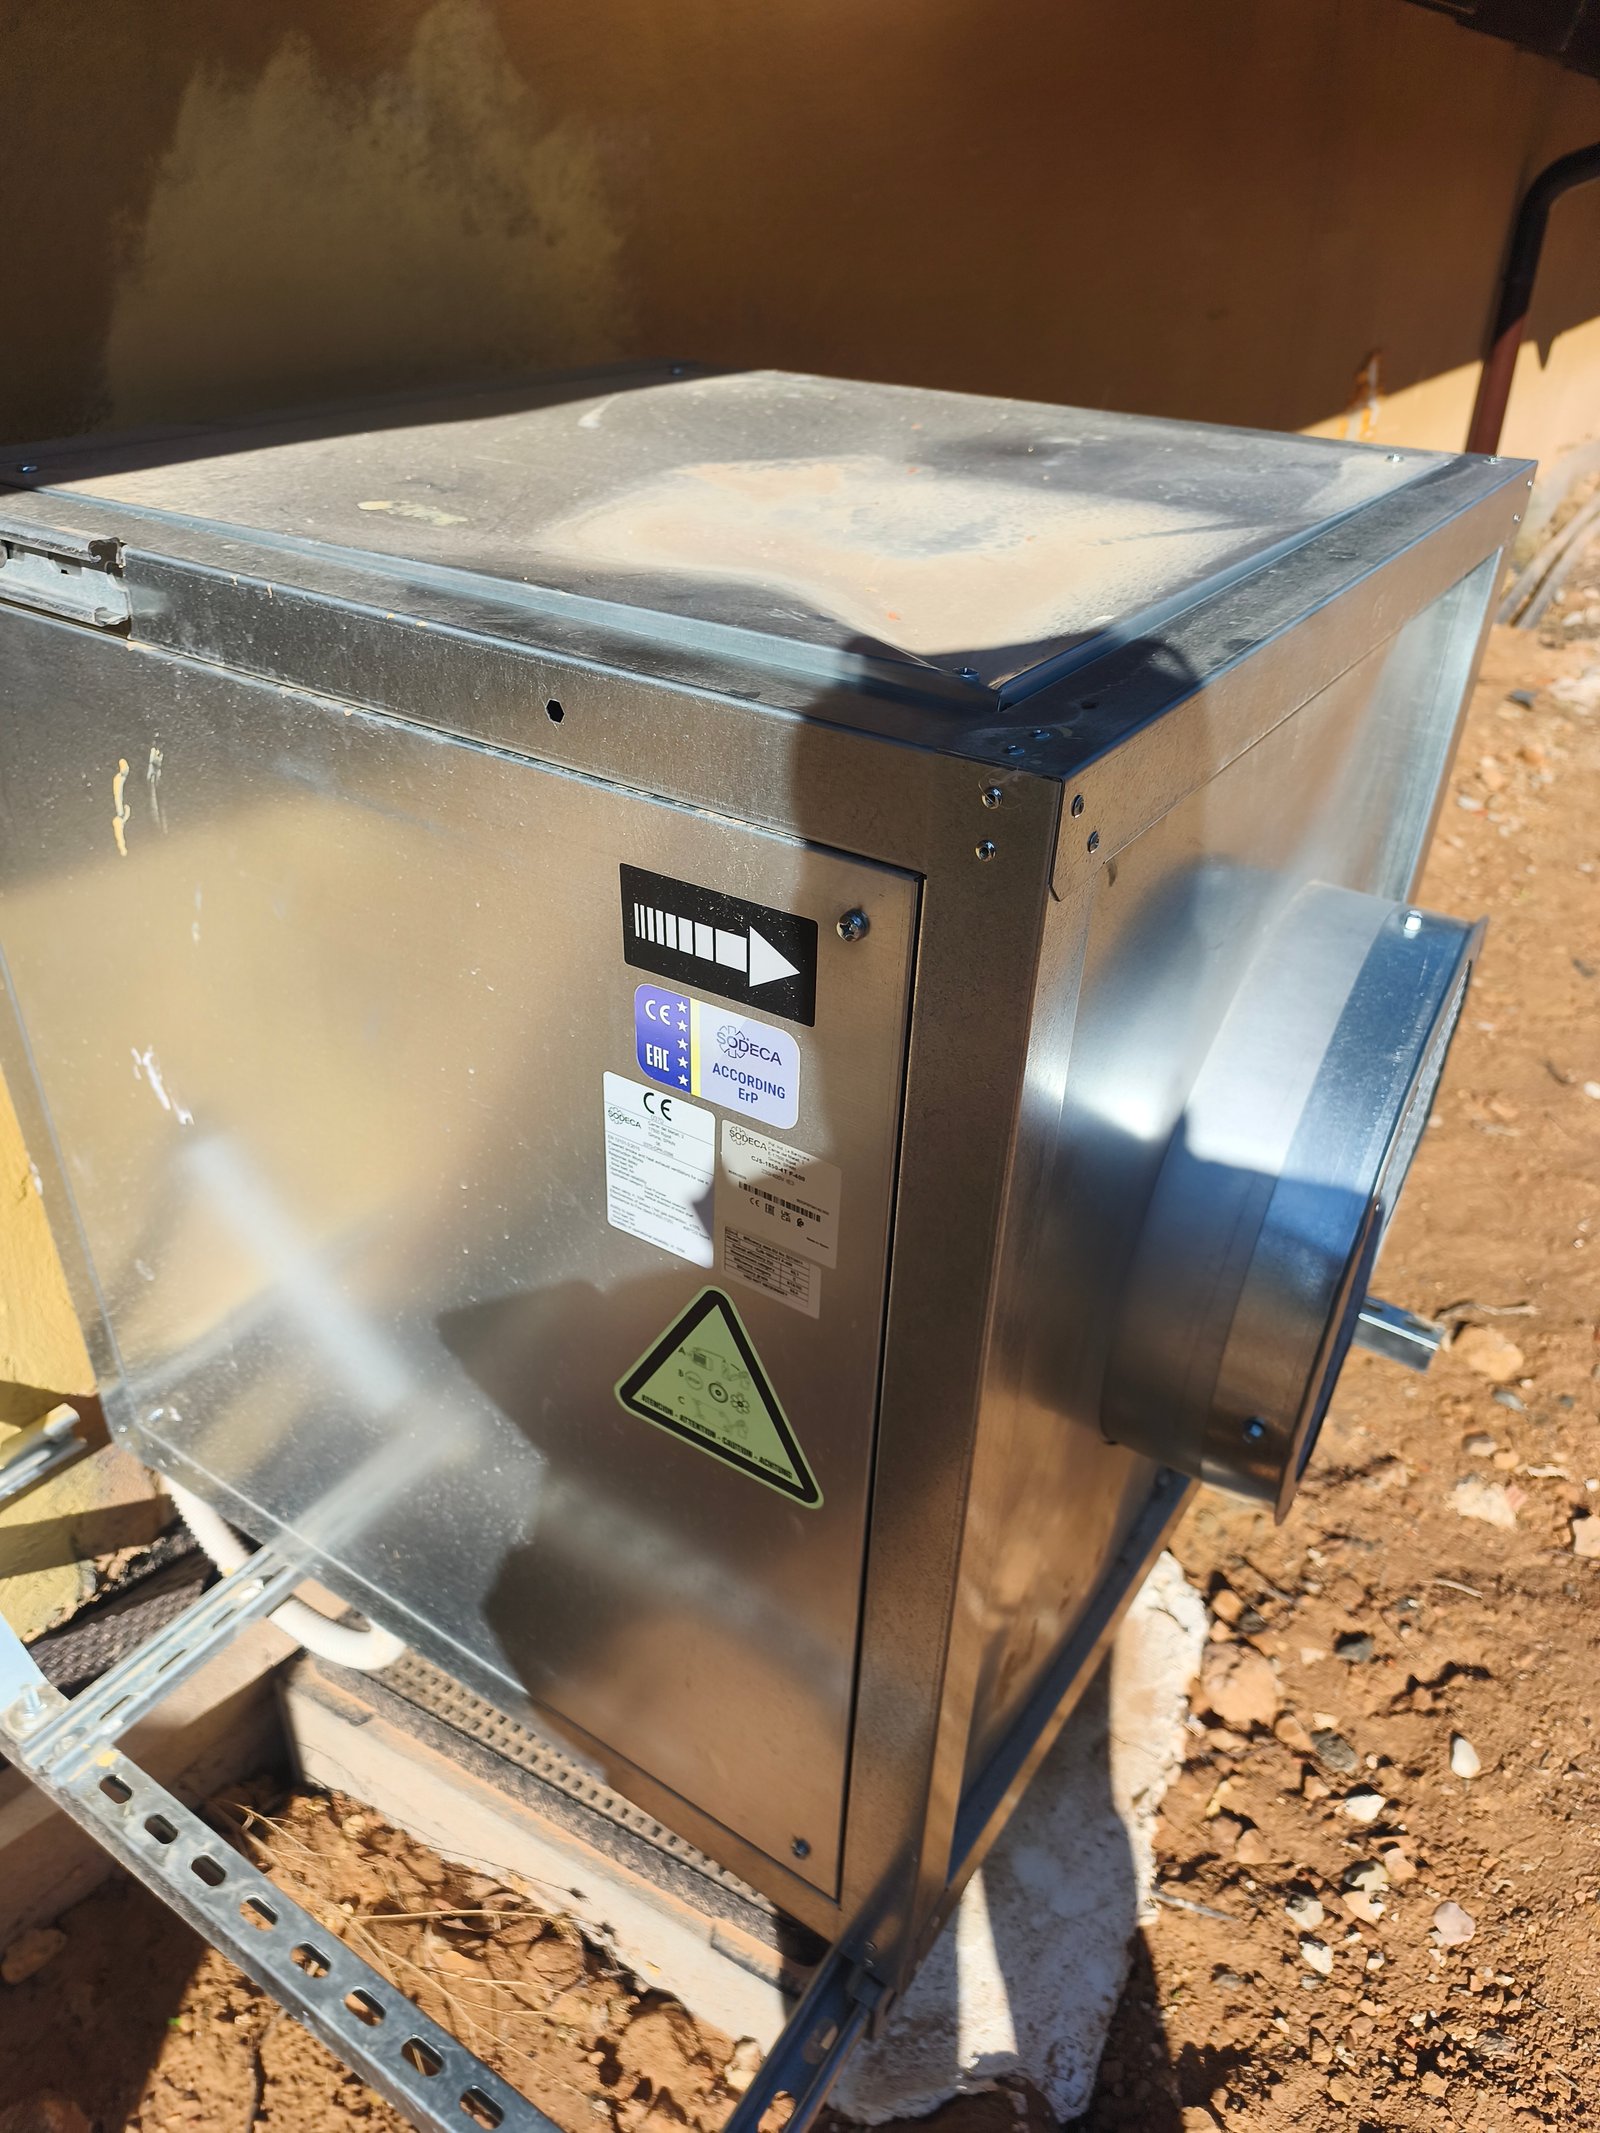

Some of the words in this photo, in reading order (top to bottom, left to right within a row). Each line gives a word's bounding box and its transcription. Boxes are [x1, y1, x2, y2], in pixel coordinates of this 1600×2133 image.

[644, 999, 671, 1026] CE
[716, 1030, 783, 1066] SODECA
[712, 1062, 786, 1100] ACCORDING
[643, 1091, 672, 1122] CE
[738, 1087, 759, 1104] ErP
[607, 1108, 643, 1130] SODECA
[729, 1129, 768, 1151] SODECA
